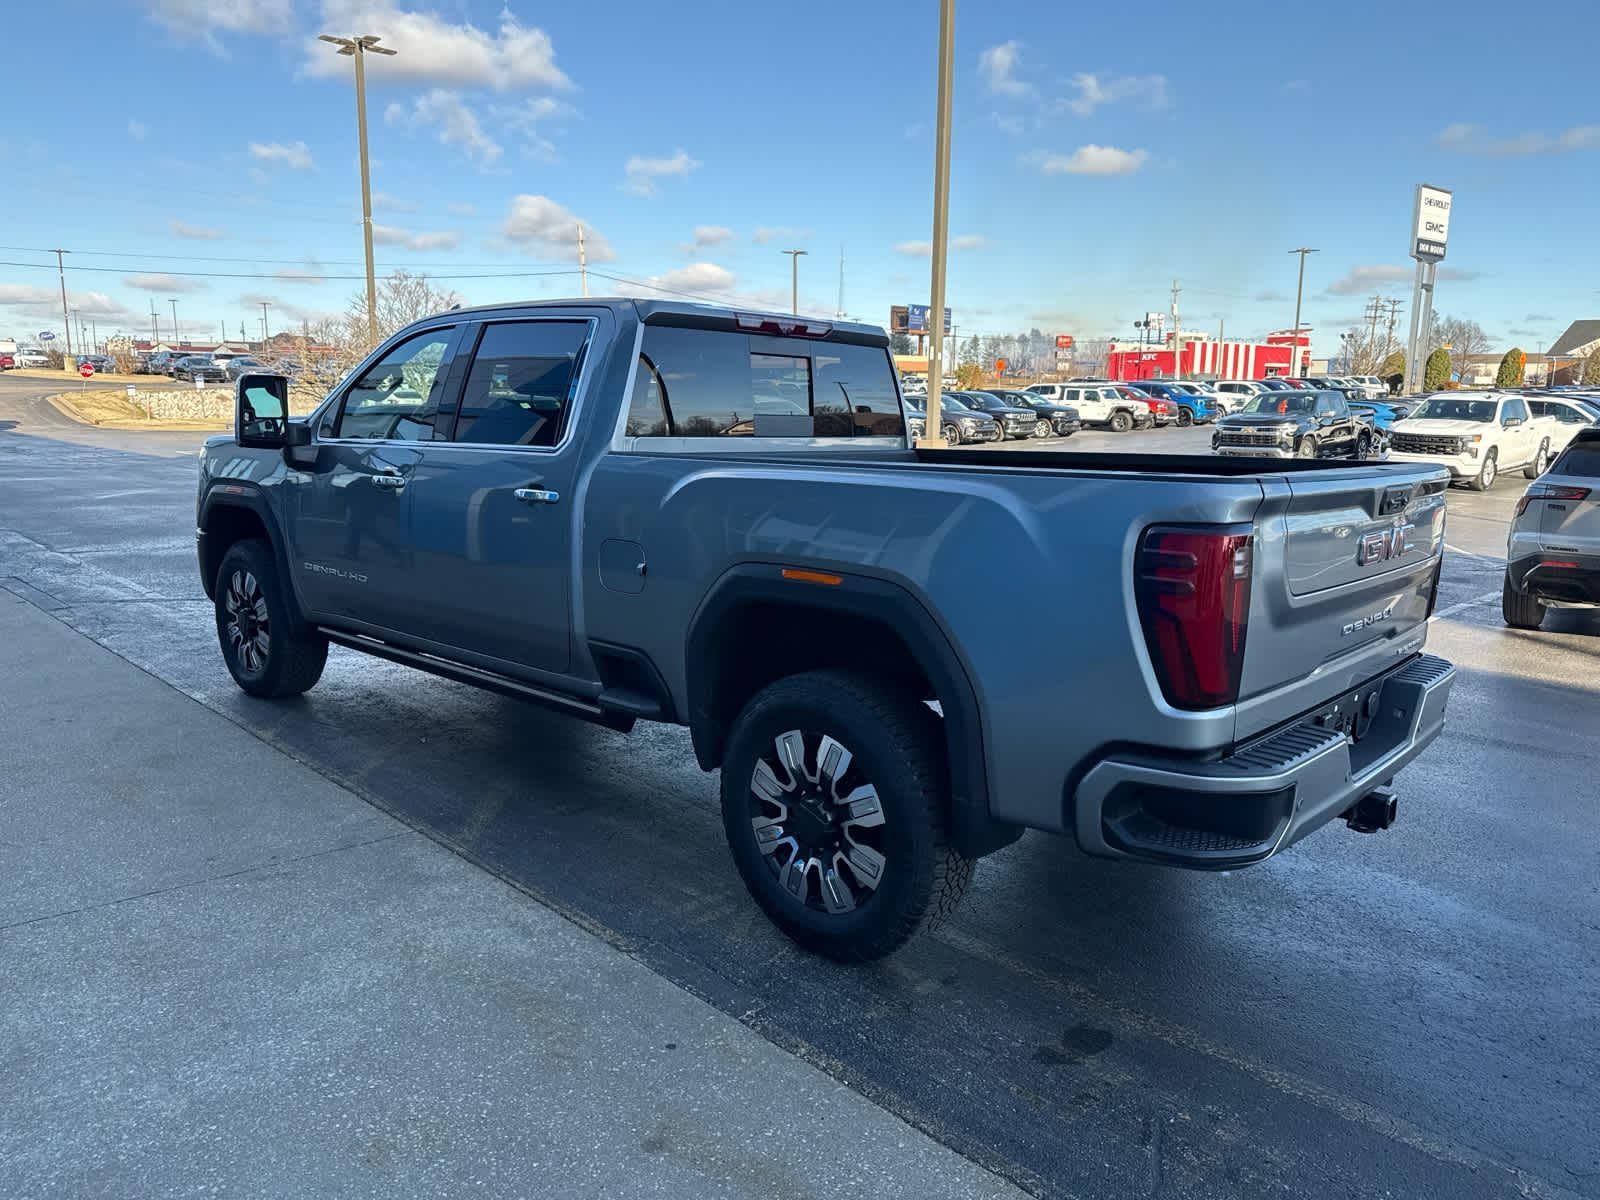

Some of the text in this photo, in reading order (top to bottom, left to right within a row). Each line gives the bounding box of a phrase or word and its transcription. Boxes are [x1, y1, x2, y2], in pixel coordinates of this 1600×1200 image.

[1425, 221, 1445, 233] GMC
[1141, 353, 1158, 361] KFC
[80, 366, 94, 374] STOP
[1358, 524, 1415, 566] GMC
[303, 562, 347, 578] DENALI
